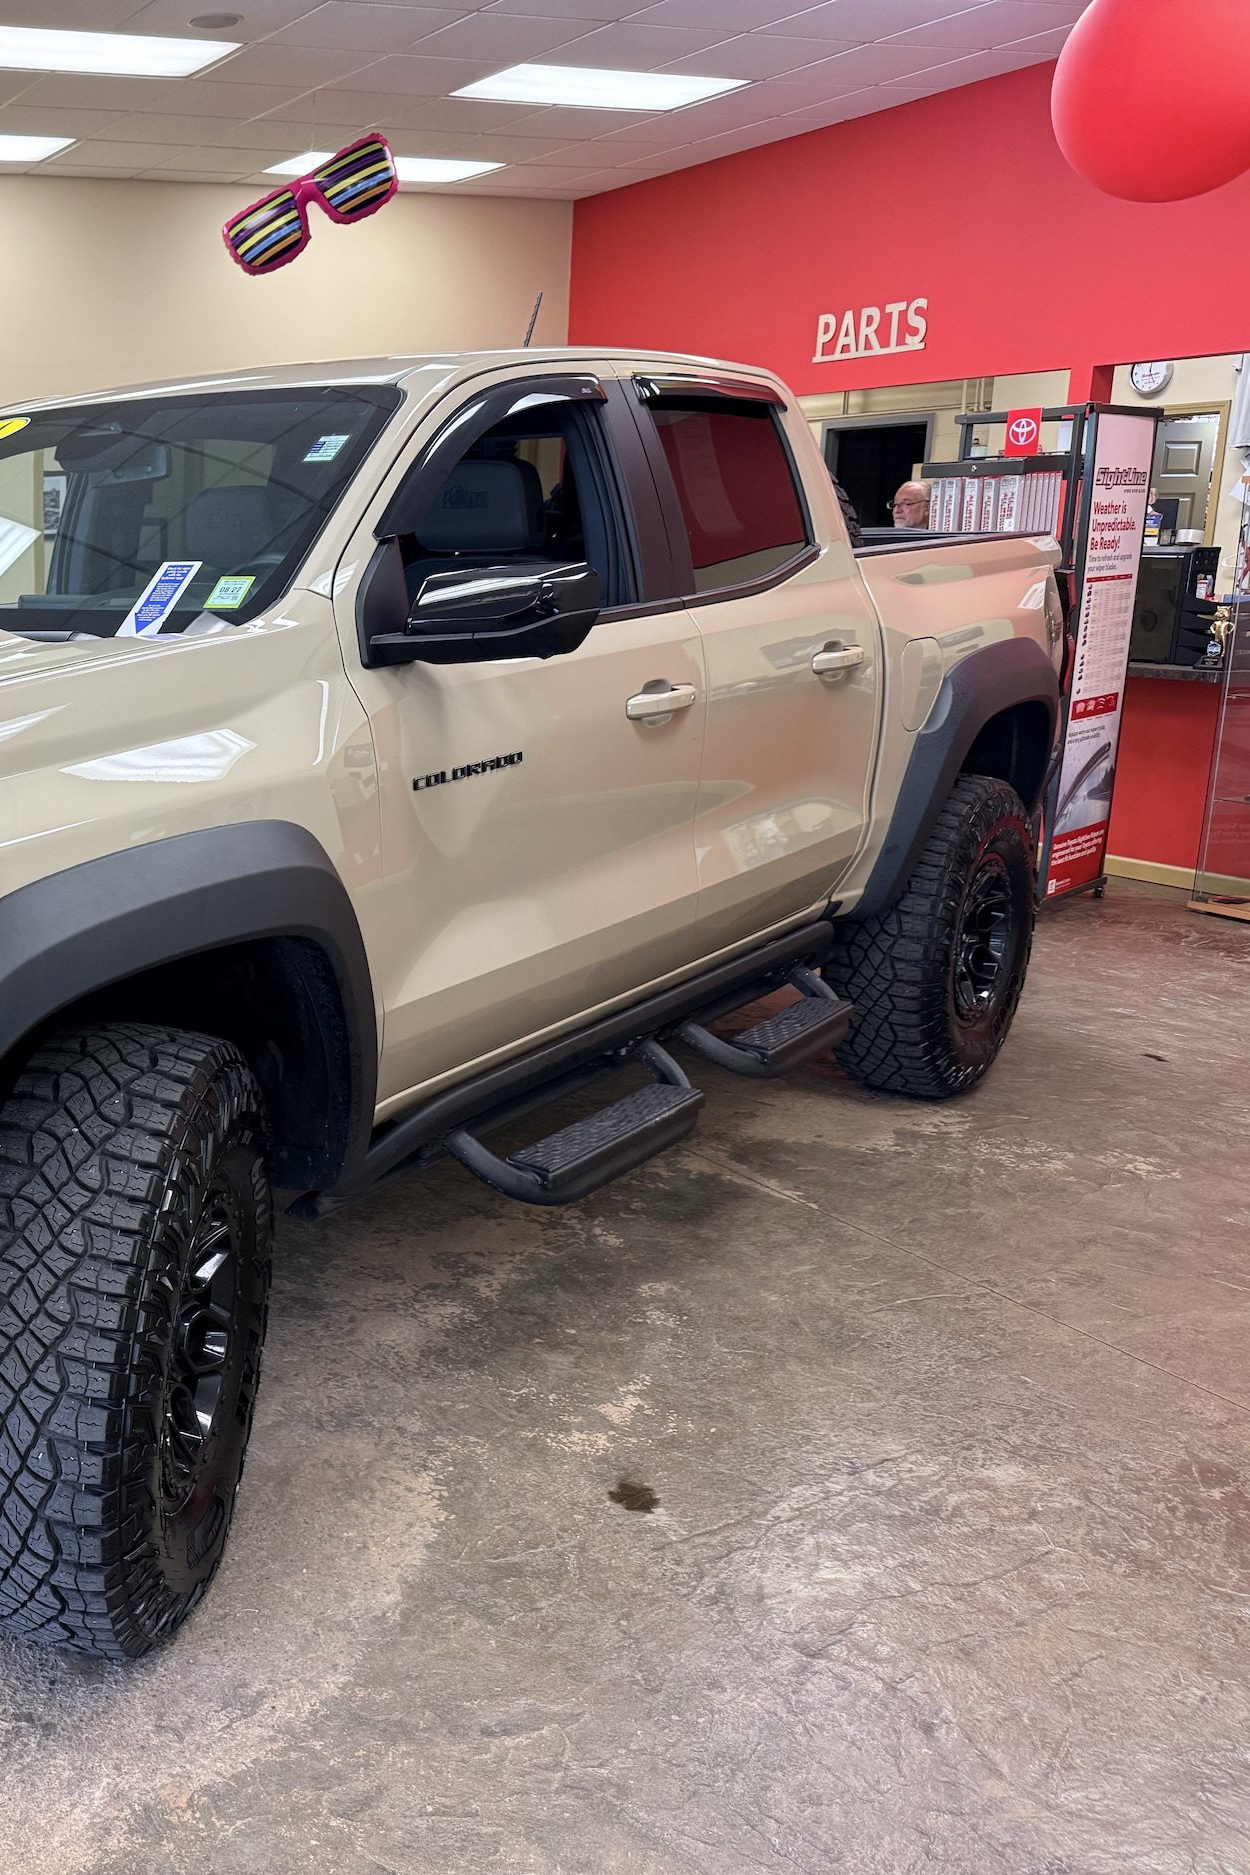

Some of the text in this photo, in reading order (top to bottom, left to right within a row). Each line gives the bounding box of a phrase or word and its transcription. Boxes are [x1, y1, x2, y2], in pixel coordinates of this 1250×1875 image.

[815, 298, 928, 357] PARTS
[1096, 467, 1147, 489] SightLine
[1093, 500, 1127, 515] Weather is
[1091, 517, 1137, 535] Unpredictable.
[1090, 536, 1121, 552] Be Ready!
[412, 751, 523, 791] COLORADO
